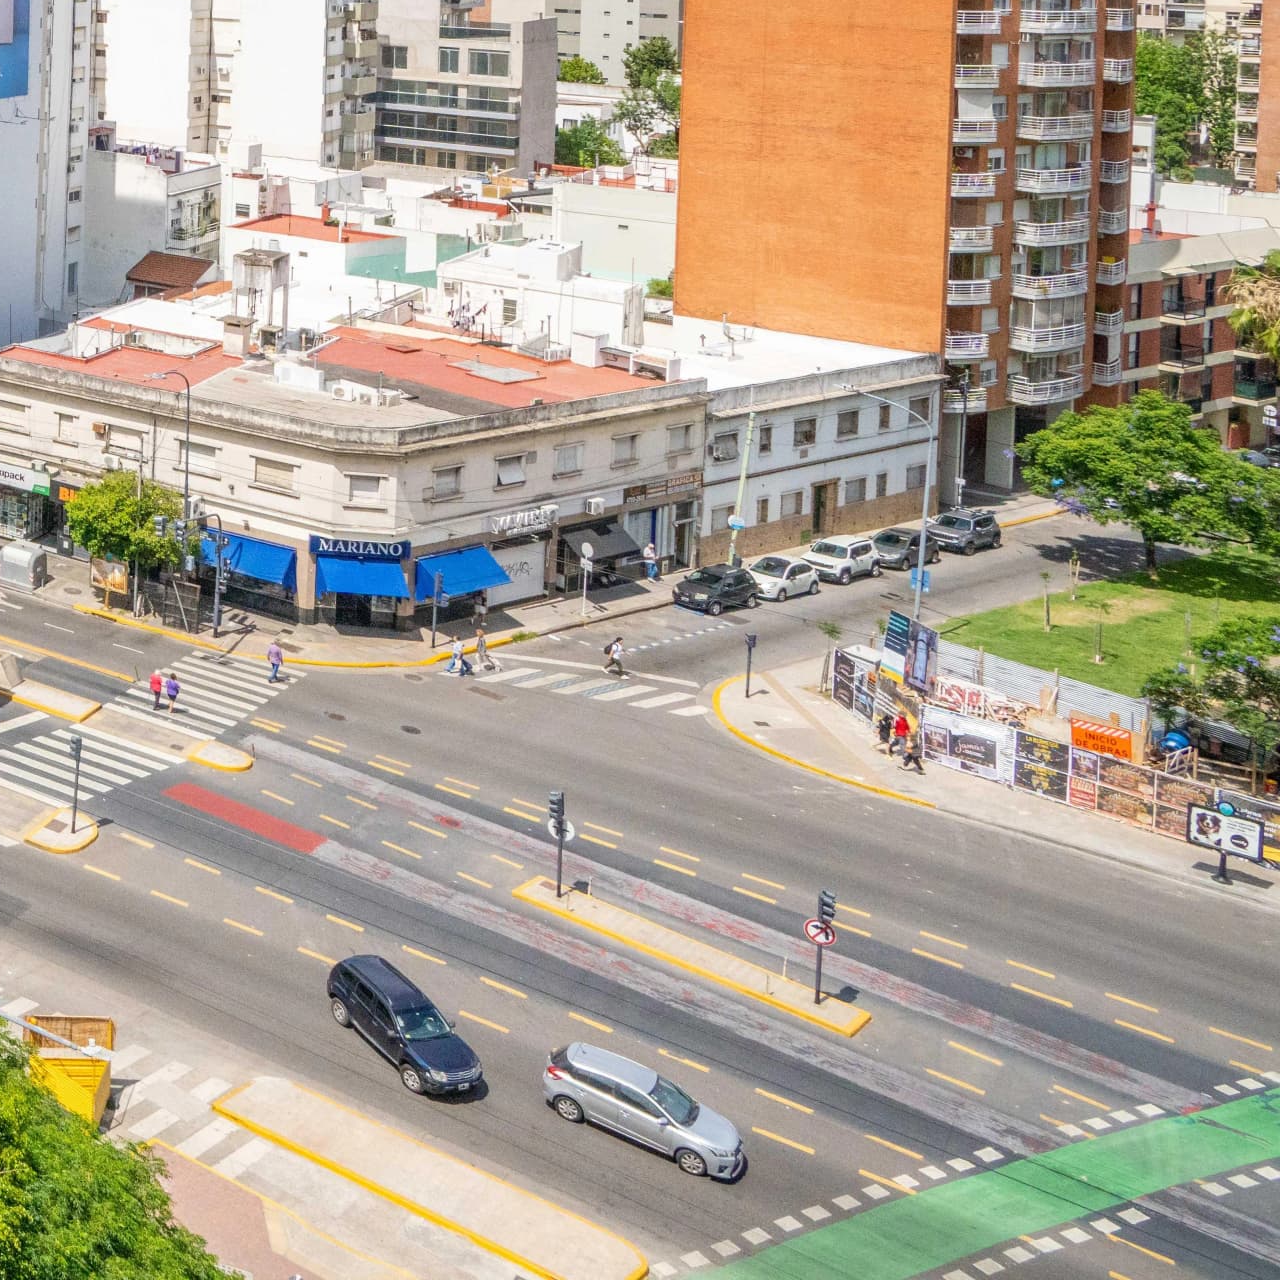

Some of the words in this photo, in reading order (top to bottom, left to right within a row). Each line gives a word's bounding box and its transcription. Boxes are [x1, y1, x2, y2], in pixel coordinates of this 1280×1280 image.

[319, 538, 403, 556] MARIANO
[1085, 731, 1117, 746] INICIO
[1075, 739, 1089, 749] DE
[1092, 743, 1129, 758] OBRAS
